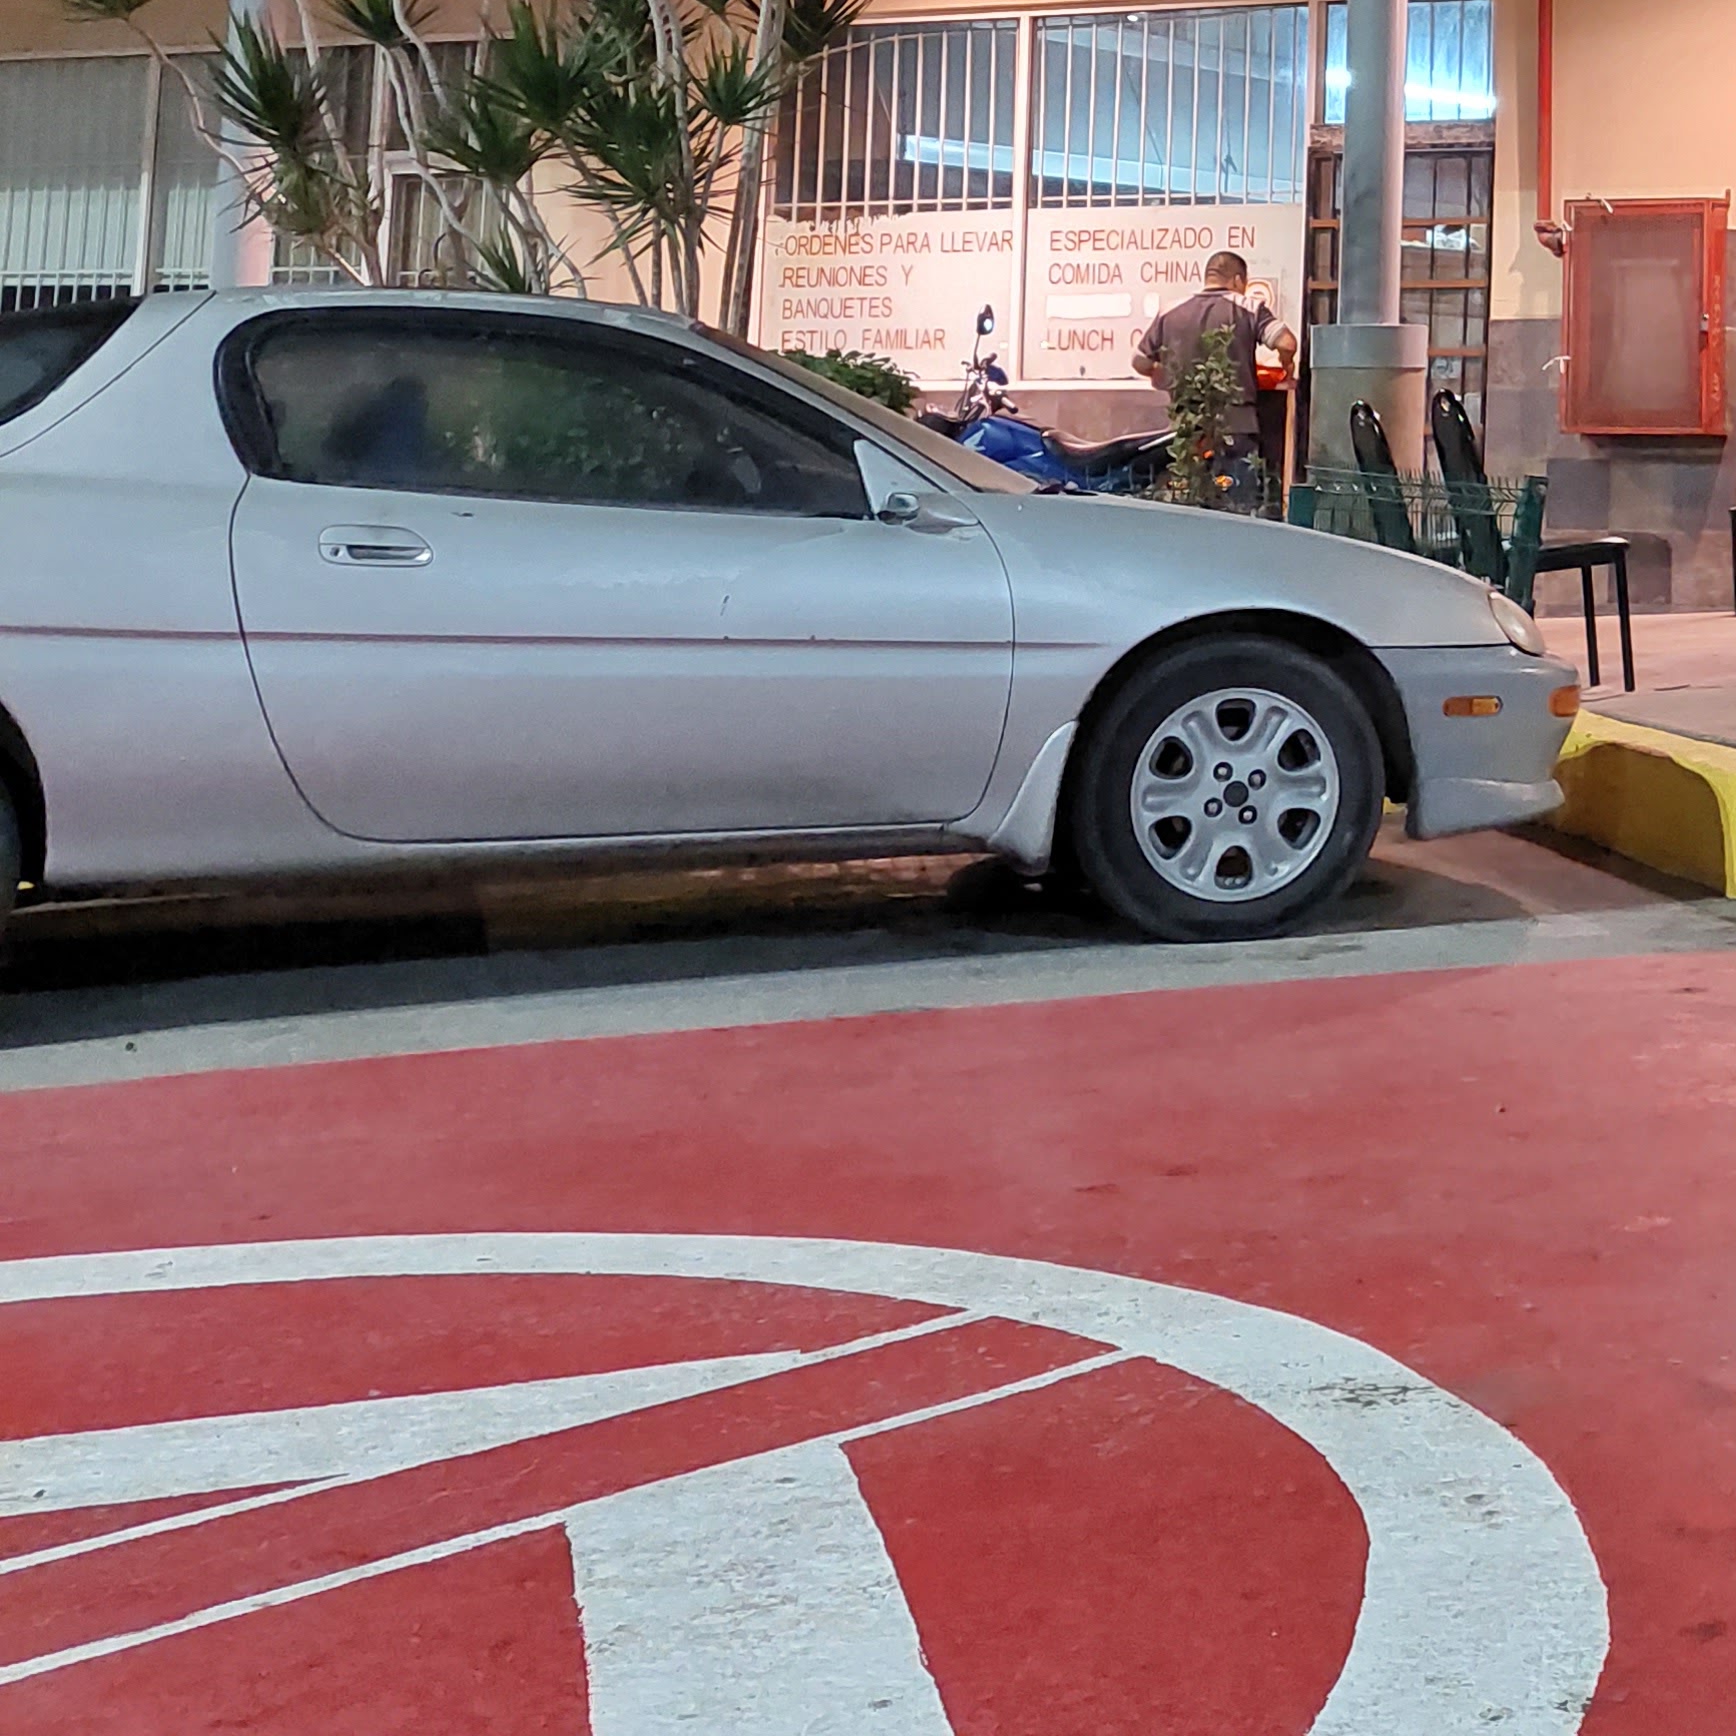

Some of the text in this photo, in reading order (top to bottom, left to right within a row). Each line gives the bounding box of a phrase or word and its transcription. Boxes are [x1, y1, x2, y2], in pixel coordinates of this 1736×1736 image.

[785, 230, 1013, 256] ORDENES PARA LLEVAR
[1050, 226, 1255, 251] ESPECIALIZADO EN
[782, 265, 913, 288] REUNIONES Y
[1049, 261, 1201, 285] COMIDA CHINA
[782, 297, 892, 319] BANQUETES
[782, 329, 945, 352] ESTILO FAMILIAR
[1047, 329, 1113, 350] LUNCH
